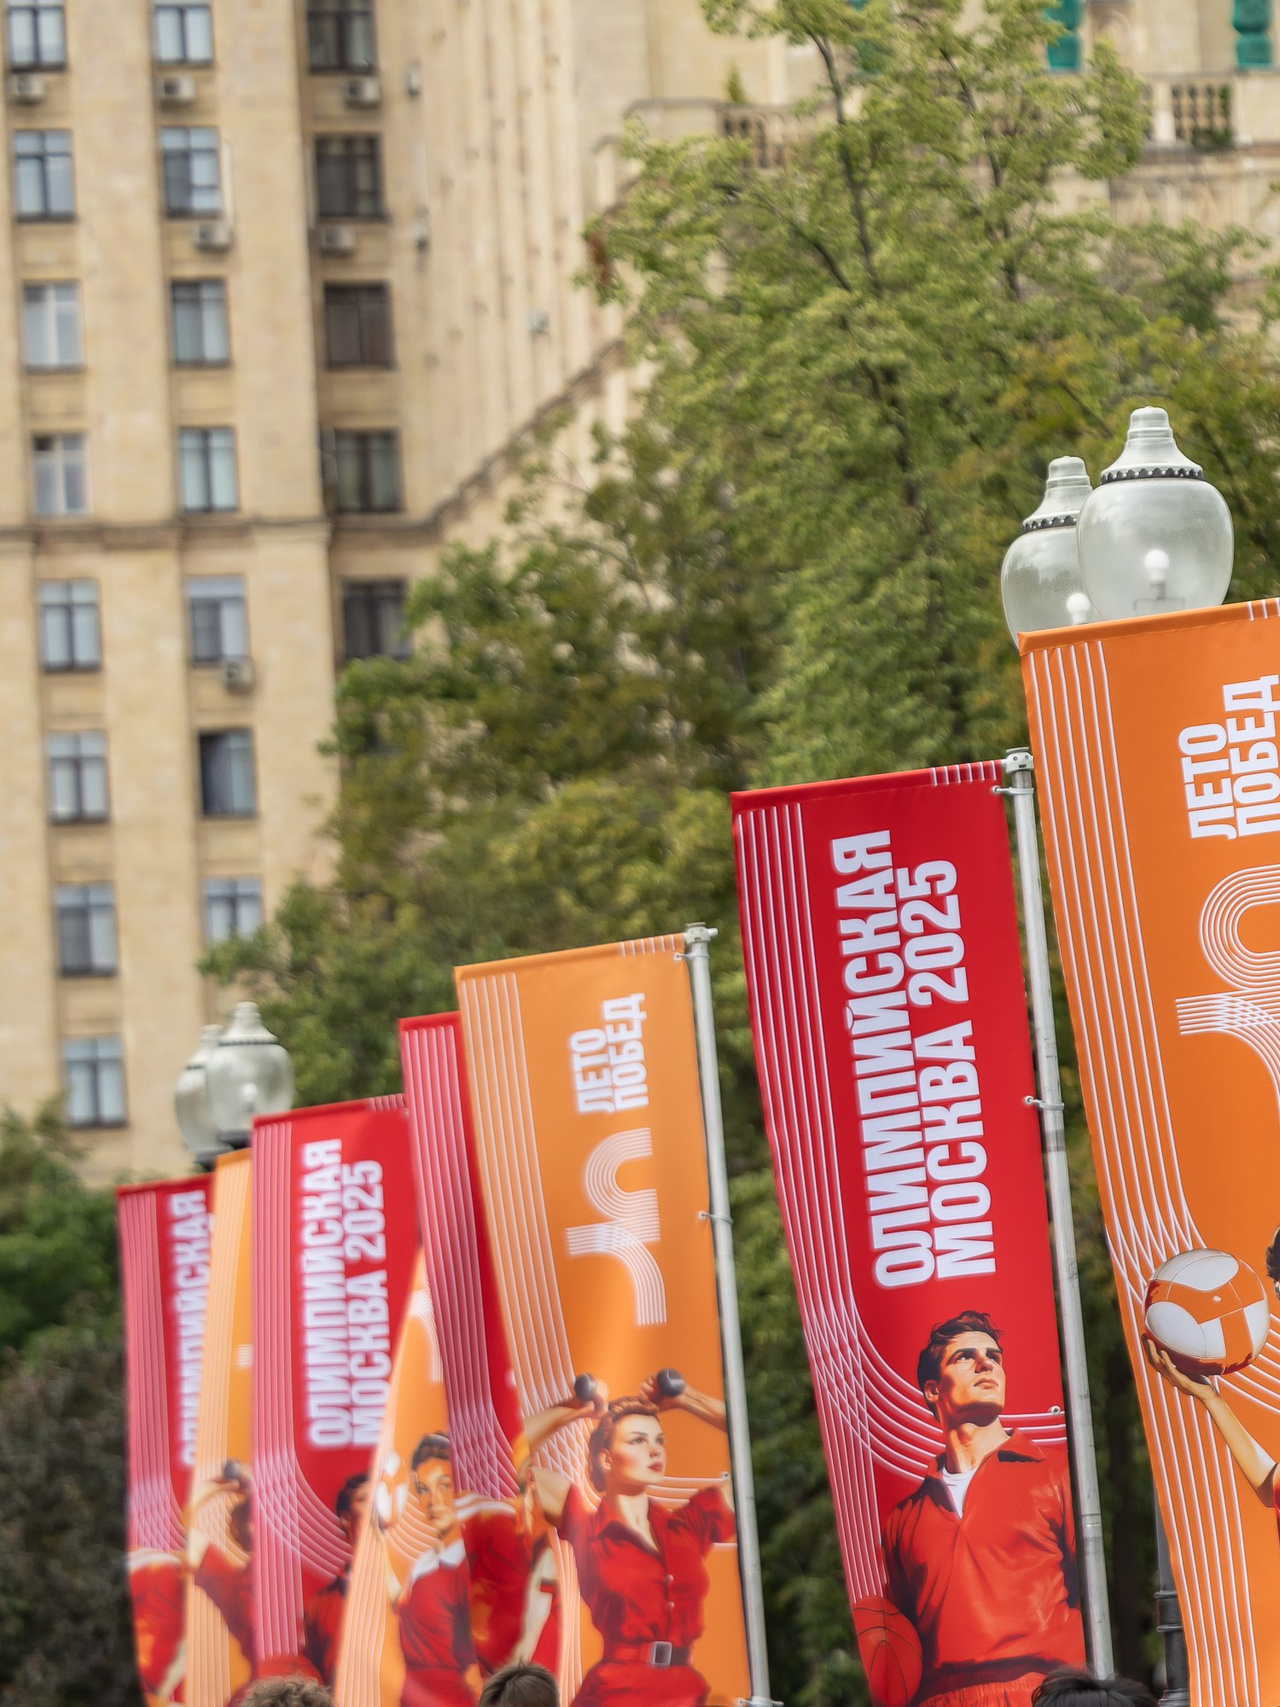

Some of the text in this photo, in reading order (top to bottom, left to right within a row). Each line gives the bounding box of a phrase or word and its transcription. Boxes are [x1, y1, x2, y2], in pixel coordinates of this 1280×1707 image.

[1178, 722, 1237, 840] ЛЕТО
[569, 1028, 616, 1114] ЛЕТО
[602, 992, 650, 1112] ПОБЕД
[828, 829, 936, 1288] ОЛИМПИЙСКАЯ
[892, 859, 997, 1280] МОСКВА 2025
[302, 1138, 351, 1446] ОЛИМПИЙСКАЯ
[341, 1160, 392, 1445] МОСКВА 2025
